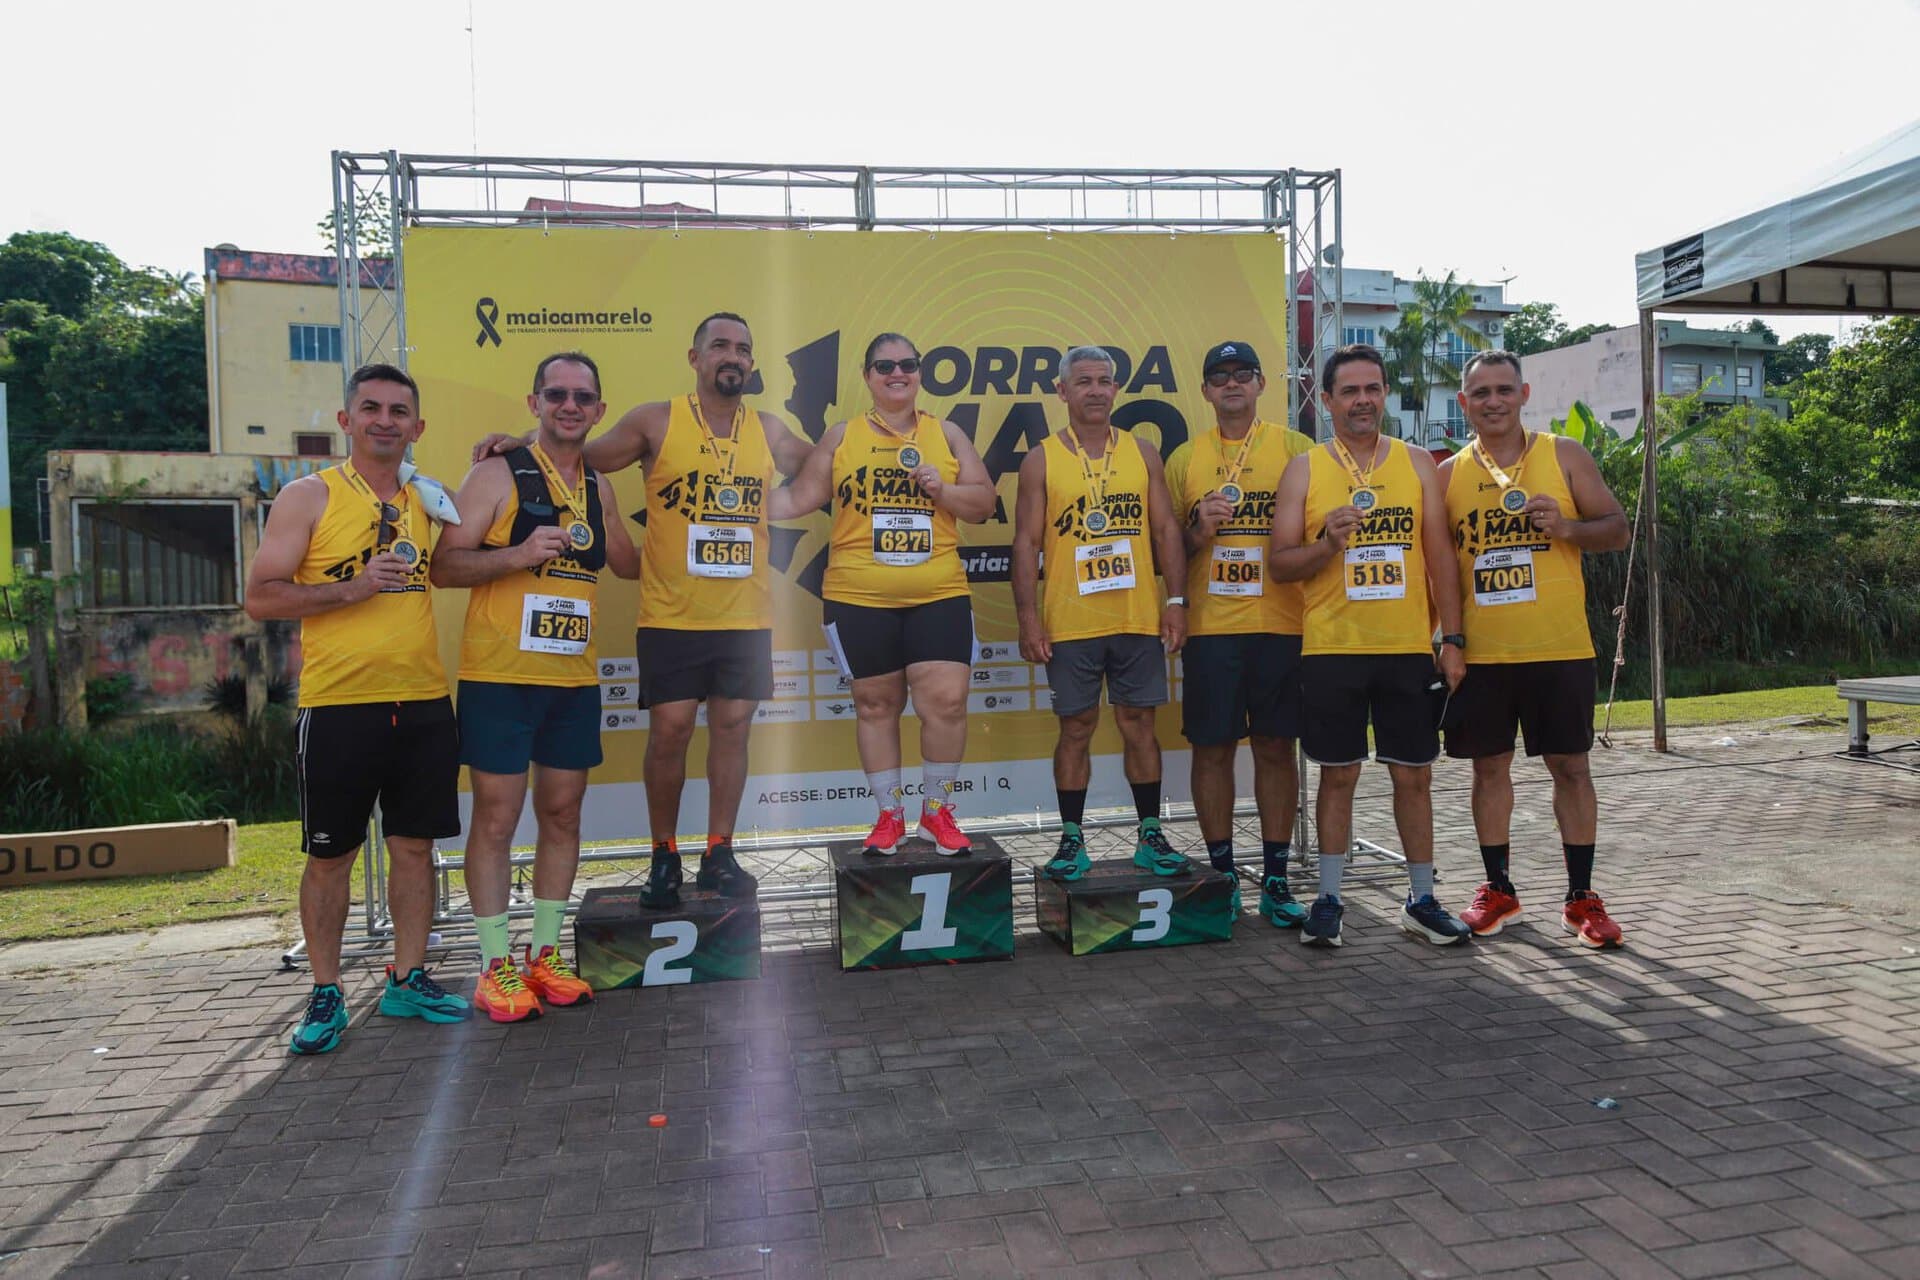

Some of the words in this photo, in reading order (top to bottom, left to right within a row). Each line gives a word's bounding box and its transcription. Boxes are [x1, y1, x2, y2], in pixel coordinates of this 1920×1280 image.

[506, 307, 653, 325] maioamarelo
[1101, 493, 1141, 506] ORRIDA
[1356, 517, 1414, 536] MAIO
[880, 530, 922, 552] 627
[702, 542, 744, 564] 656
[1085, 556, 1125, 581] 196
[1216, 563, 1252, 582] 180
[1353, 563, 1396, 586] 518
[1479, 566, 1524, 592] 700
[538, 613, 581, 640] 573
[758, 790, 823, 805] ACESSE:
[900, 872, 958, 950] 1
[1132, 888, 1174, 942] 3
[641, 920, 698, 986] 2
